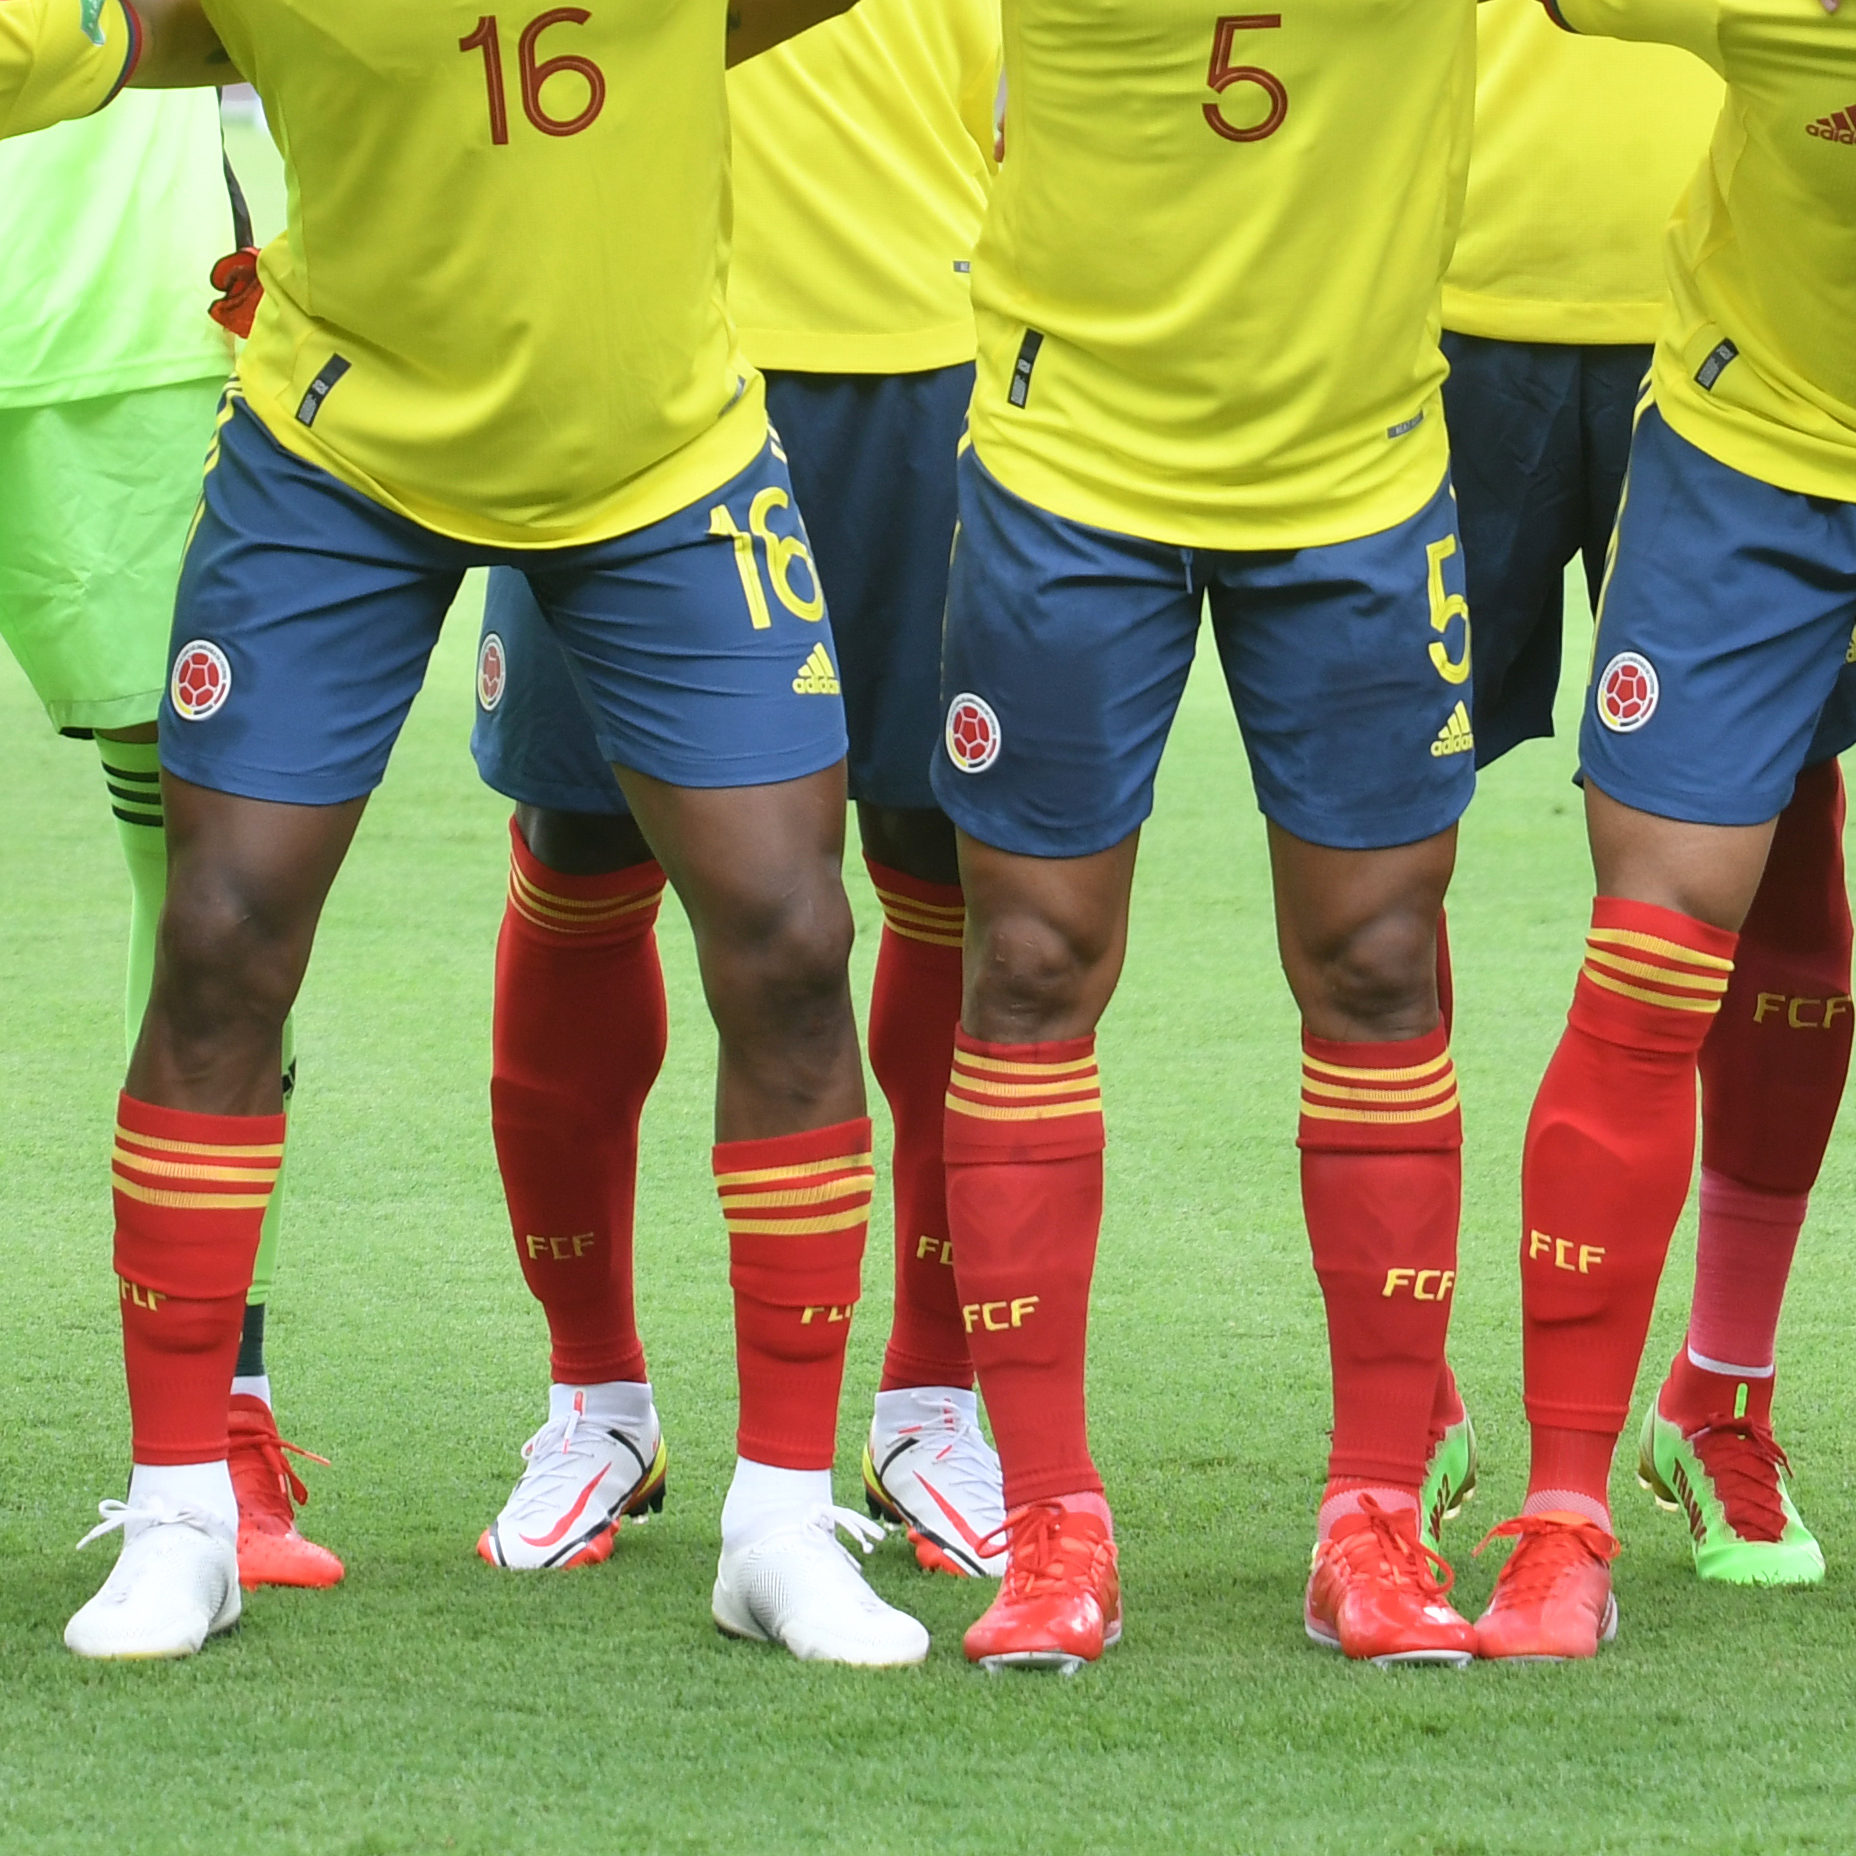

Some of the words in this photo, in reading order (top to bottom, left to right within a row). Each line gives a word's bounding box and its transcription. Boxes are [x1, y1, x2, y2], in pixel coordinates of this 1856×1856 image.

[458, 7, 606, 145] 16
[1201, 13, 1289, 142] 5
[707, 486, 825, 630] 16
[1426, 534, 1472, 685] 5
[1752, 990, 1853, 1030] FCF
[524, 1231, 596, 1262] FCF
[916, 1234, 952, 1266] FC
[1528, 1227, 1606, 1275] FCF
[1381, 1267, 1456, 1302] FCF
[963, 1295, 1041, 1334] FCF
